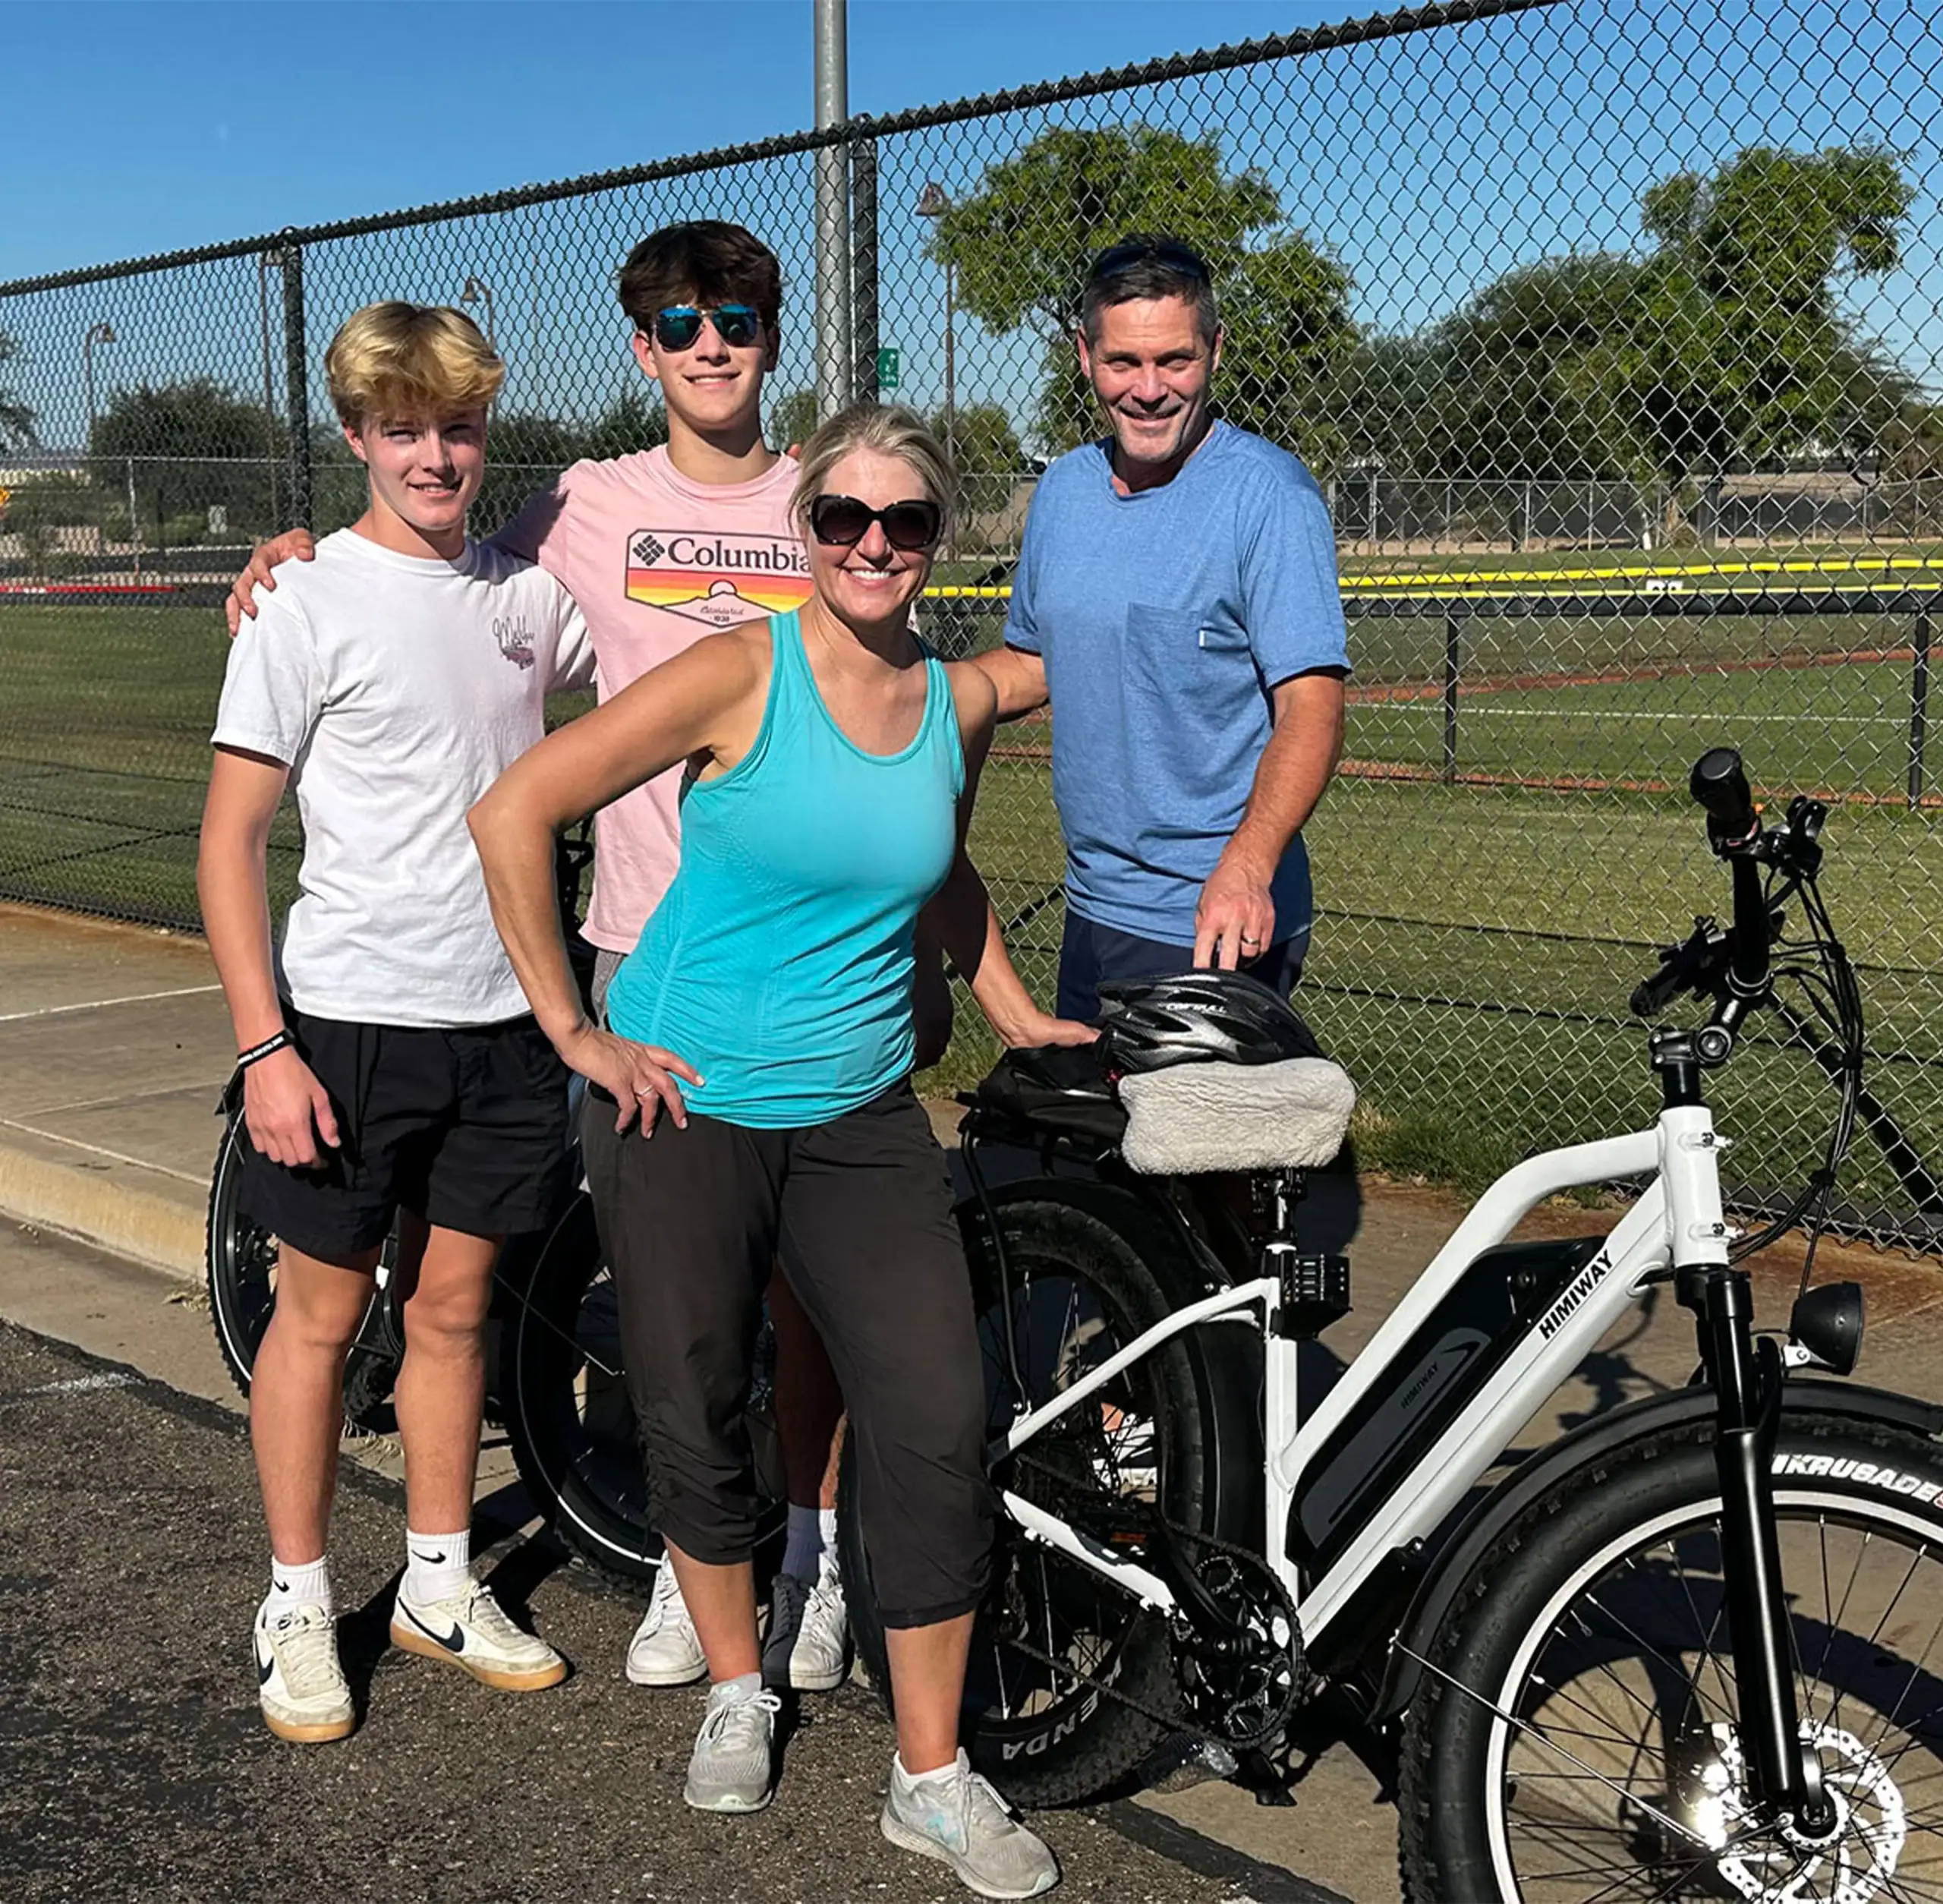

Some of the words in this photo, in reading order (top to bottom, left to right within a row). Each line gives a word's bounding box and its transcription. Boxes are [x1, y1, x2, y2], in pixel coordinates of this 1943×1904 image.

[668, 537, 810, 572] Columbia
[1538, 1248, 1613, 1341] HIMIWAY
[1400, 1360, 1439, 1410] HIMIWAY
